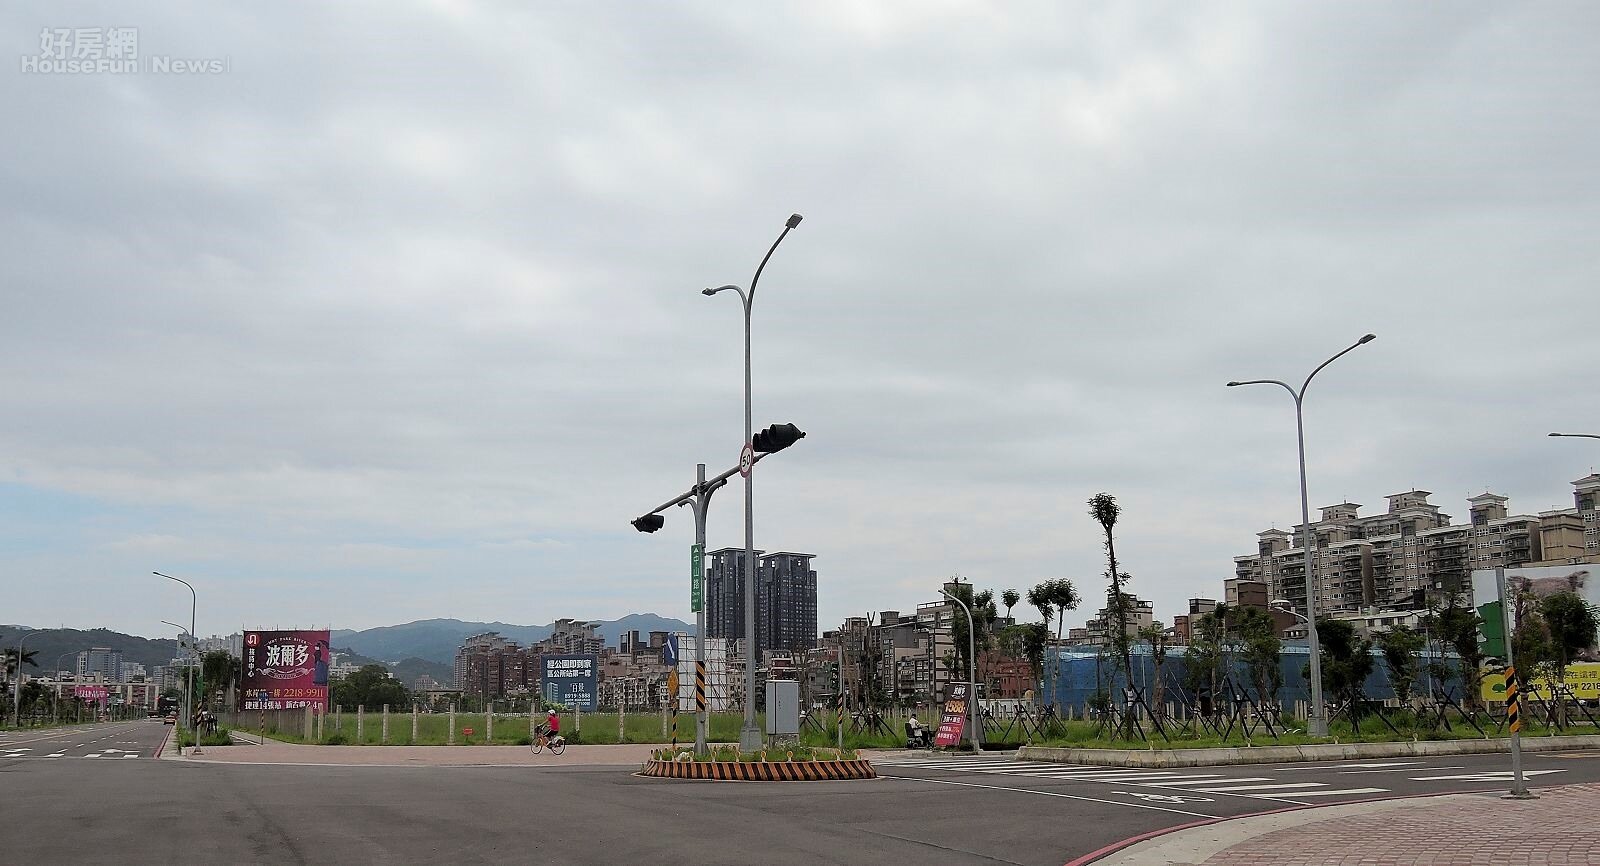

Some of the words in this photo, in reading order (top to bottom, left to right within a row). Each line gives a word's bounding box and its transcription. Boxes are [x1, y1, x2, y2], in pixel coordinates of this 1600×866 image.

[742, 454, 750, 467] 50
[266, 644, 309, 666] 波爾多
[283, 688, 323, 697] 2218-9911
